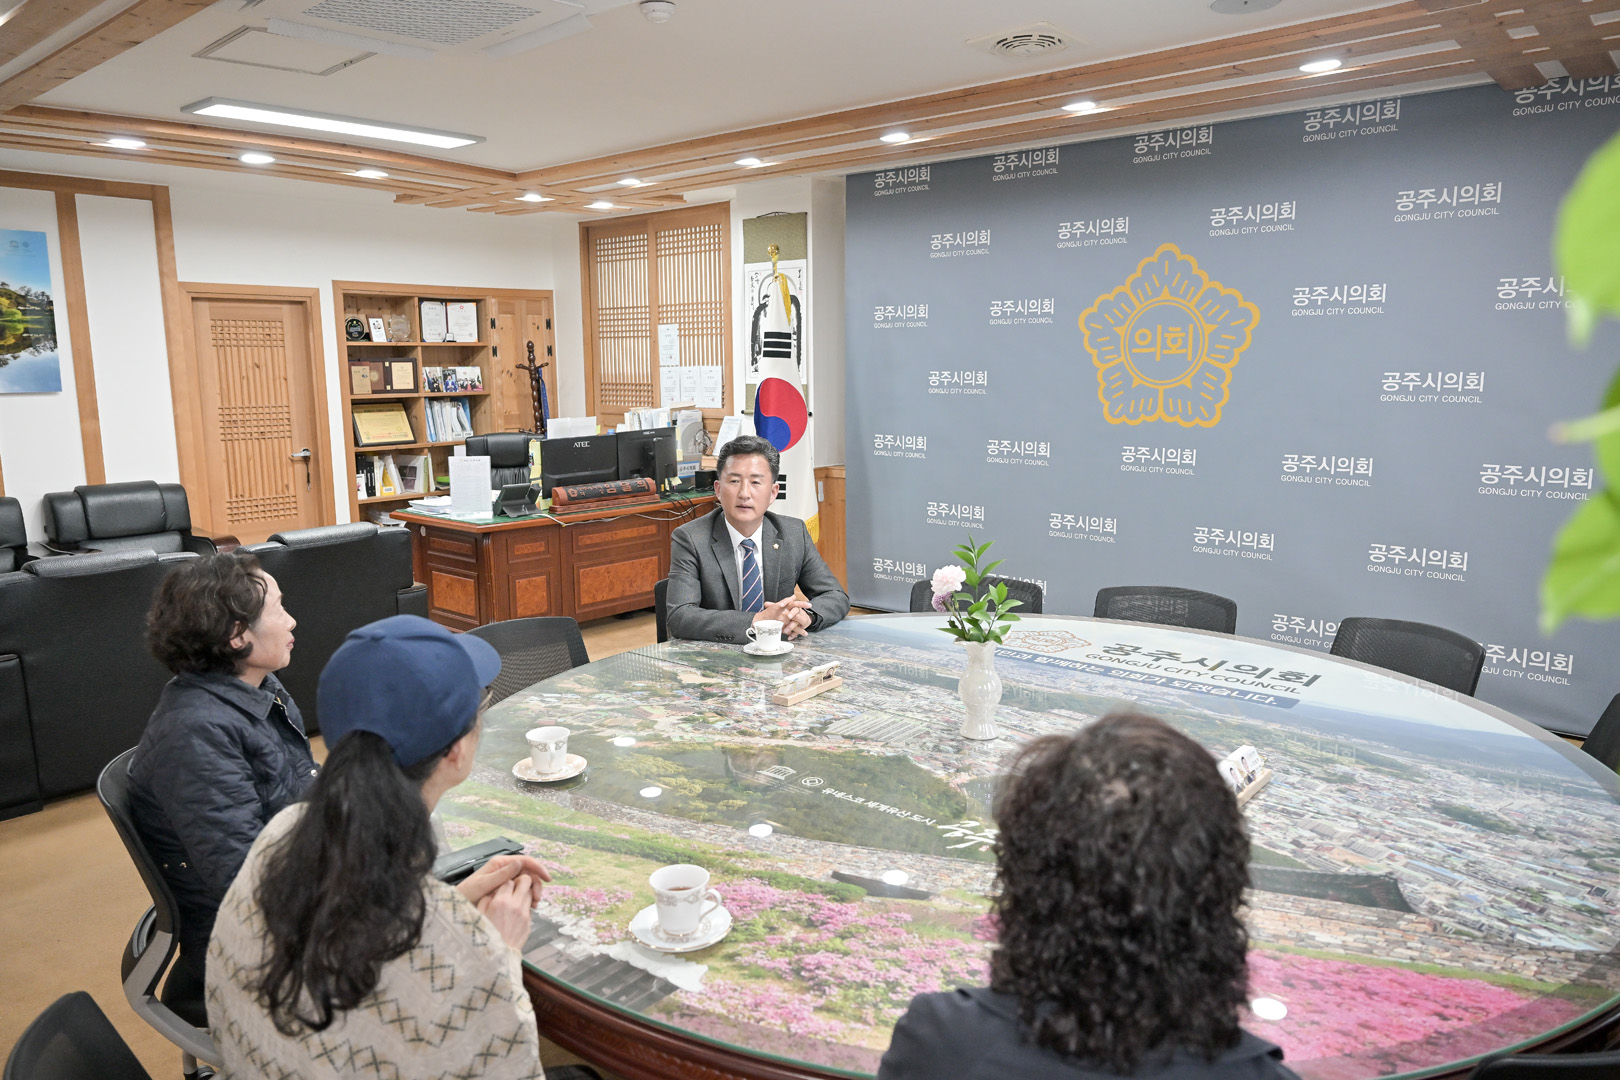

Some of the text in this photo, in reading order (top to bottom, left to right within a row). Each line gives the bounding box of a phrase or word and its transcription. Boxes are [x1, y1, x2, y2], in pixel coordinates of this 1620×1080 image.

[1303, 99, 1402, 132] 공주시의회
[1513, 104, 1554, 116] GONGJU
[1557, 100, 1581, 111] CITY
[1133, 126, 1214, 154] 공주시의회
[1303, 124, 1399, 143] GONGJU CITY COUNCIL
[992, 148, 1060, 172] 공주시의회
[1133, 148, 1212, 164] GONGJU CITY COUNCIL
[874, 166, 931, 188] 공주시의회
[992, 173, 1016, 182] GONGJU
[1032, 168, 1059, 177] COUNCIL
[874, 189, 895, 197] GONGJU
[907, 184, 930, 192] COUNCIL
[1395, 182, 1502, 211] 공주시의회
[1210, 201, 1296, 227] 공주시의회
[1394, 208, 1500, 222] GONGJU CITY COUNCIL
[1058, 216, 1128, 239] 공주시의회
[1209, 224, 1295, 236] GONGJU CITY COUNCIL
[930, 229, 990, 250] 공주시의회
[1056, 241, 1082, 249] GONGJU
[1100, 237, 1128, 246] COUNCIL
[966, 248, 990, 256] COUNCIL
[1292, 283, 1387, 306] 공주시의회
[1497, 275, 1566, 299] 공주시
[874, 304, 928, 321] 공주시의회
[989, 298, 1054, 317] 공주시의회
[1348, 306, 1385, 314] COUNCIL
[1495, 302, 1535, 310] GONGJU
[1538, 300, 1561, 309] CITY
[1132, 323, 1194, 361] 의회
[928, 370, 987, 386] 공주시의회
[1381, 371, 1485, 392] 공주시의회
[1380, 394, 1416, 402] GONGJU
[1442, 395, 1482, 403] COUNCIL
[874, 434, 927, 451] 공주시의회
[987, 440, 1050, 458] 공주시의회
[1121, 446, 1196, 466] 공주시의회
[1282, 454, 1373, 477] 공주시의회
[1120, 464, 1147, 472] GONGJU
[1479, 464, 1594, 489] 공주시의회
[1280, 475, 1313, 483] GONGJU
[1335, 478, 1371, 486] COUNCIL
[1478, 487, 1591, 500] GONGJU CITY COUNCIL
[926, 502, 984, 521] 공주시의회
[960, 521, 984, 529] COUNCIL
[1049, 513, 1117, 535] 공주시의회
[1049, 530, 1073, 538] GONGJU
[1089, 534, 1116, 543] COUNCIL
[1193, 526, 1274, 551] 공주시의회
[1192, 546, 1221, 555] GONGJU
[1241, 551, 1273, 560] COUNCIL
[1368, 544, 1468, 571] 공주시의회
[873, 558, 926, 578] 공주시의회
[1367, 564, 1466, 582] GONGJU CITY COUNCIL
[1272, 614, 1341, 638] 공주시의
[1271, 633, 1302, 644] GONGJU
[1304, 638, 1321, 646] CITY
[1103, 643, 1322, 687] 공주시의회
[1479, 642, 1574, 675] 주시의회
[1034, 655, 1104, 673] 함께하는
[1107, 669, 1167, 684] 의회가
[1169, 678, 1278, 705] 되겠습니다.
[1085, 653, 1301, 695] GONGJU CITY COUNCIL
[1503, 669, 1524, 678] CITY
[1527, 672, 1571, 686] COUNCIL
[822, 787, 936, 826] 유네스코 세계유산 도시
